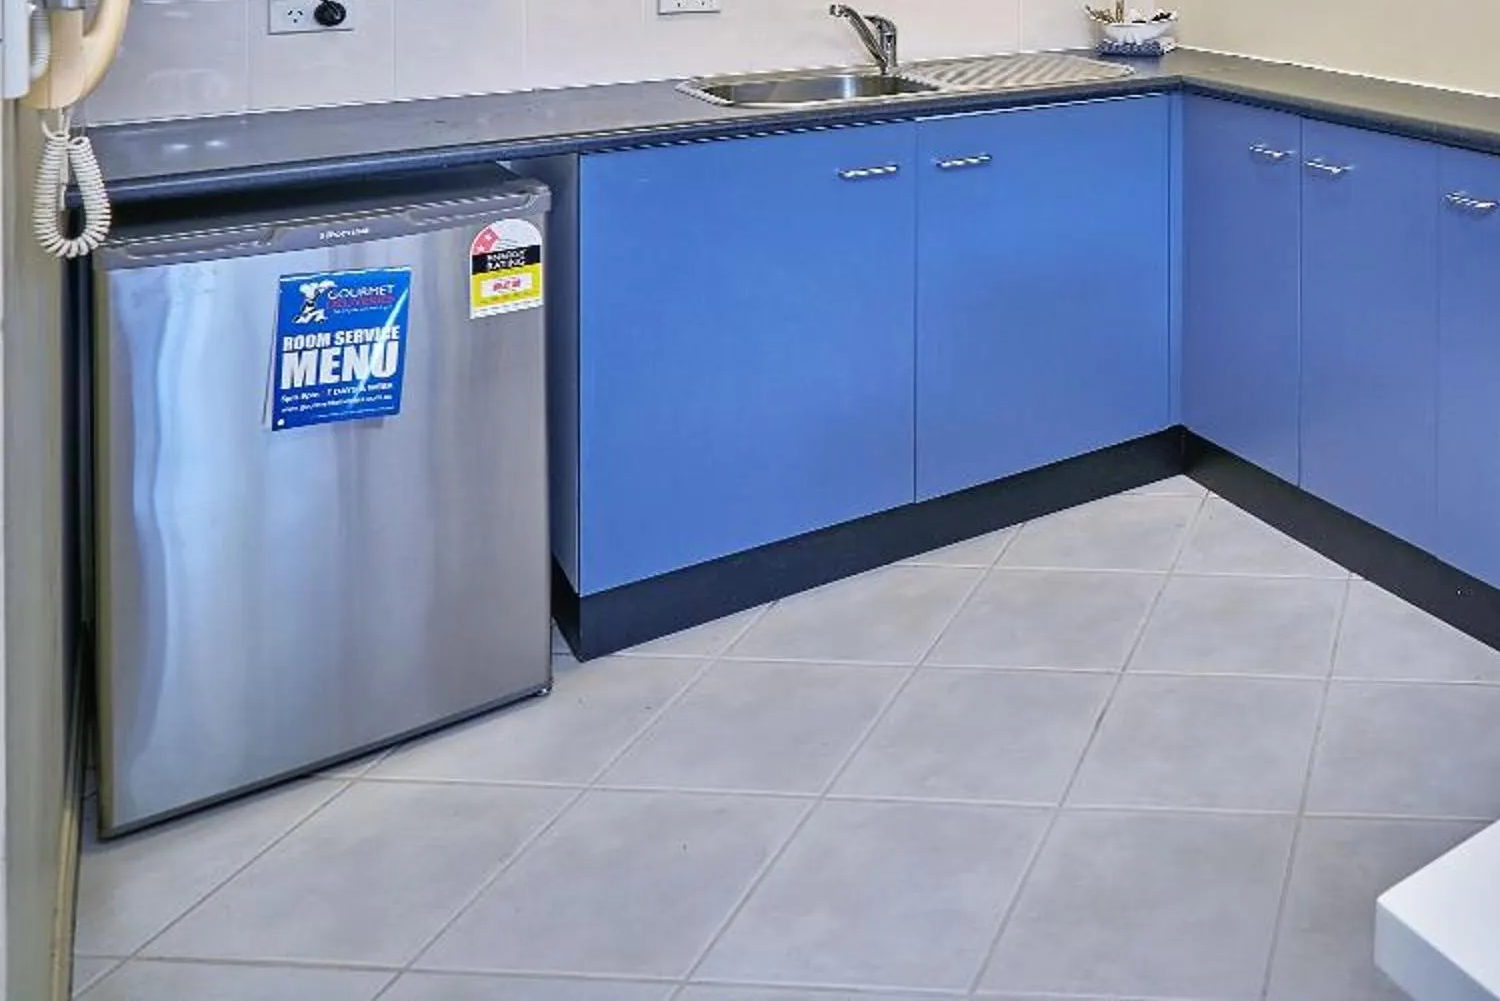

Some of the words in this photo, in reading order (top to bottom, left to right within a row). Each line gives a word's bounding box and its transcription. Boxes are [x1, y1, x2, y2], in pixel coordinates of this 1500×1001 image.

[327, 284, 395, 300] GOURMET
[283, 332, 331, 351] ROOM
[334, 325, 401, 346] SERVICE
[280, 340, 399, 390] MENU
